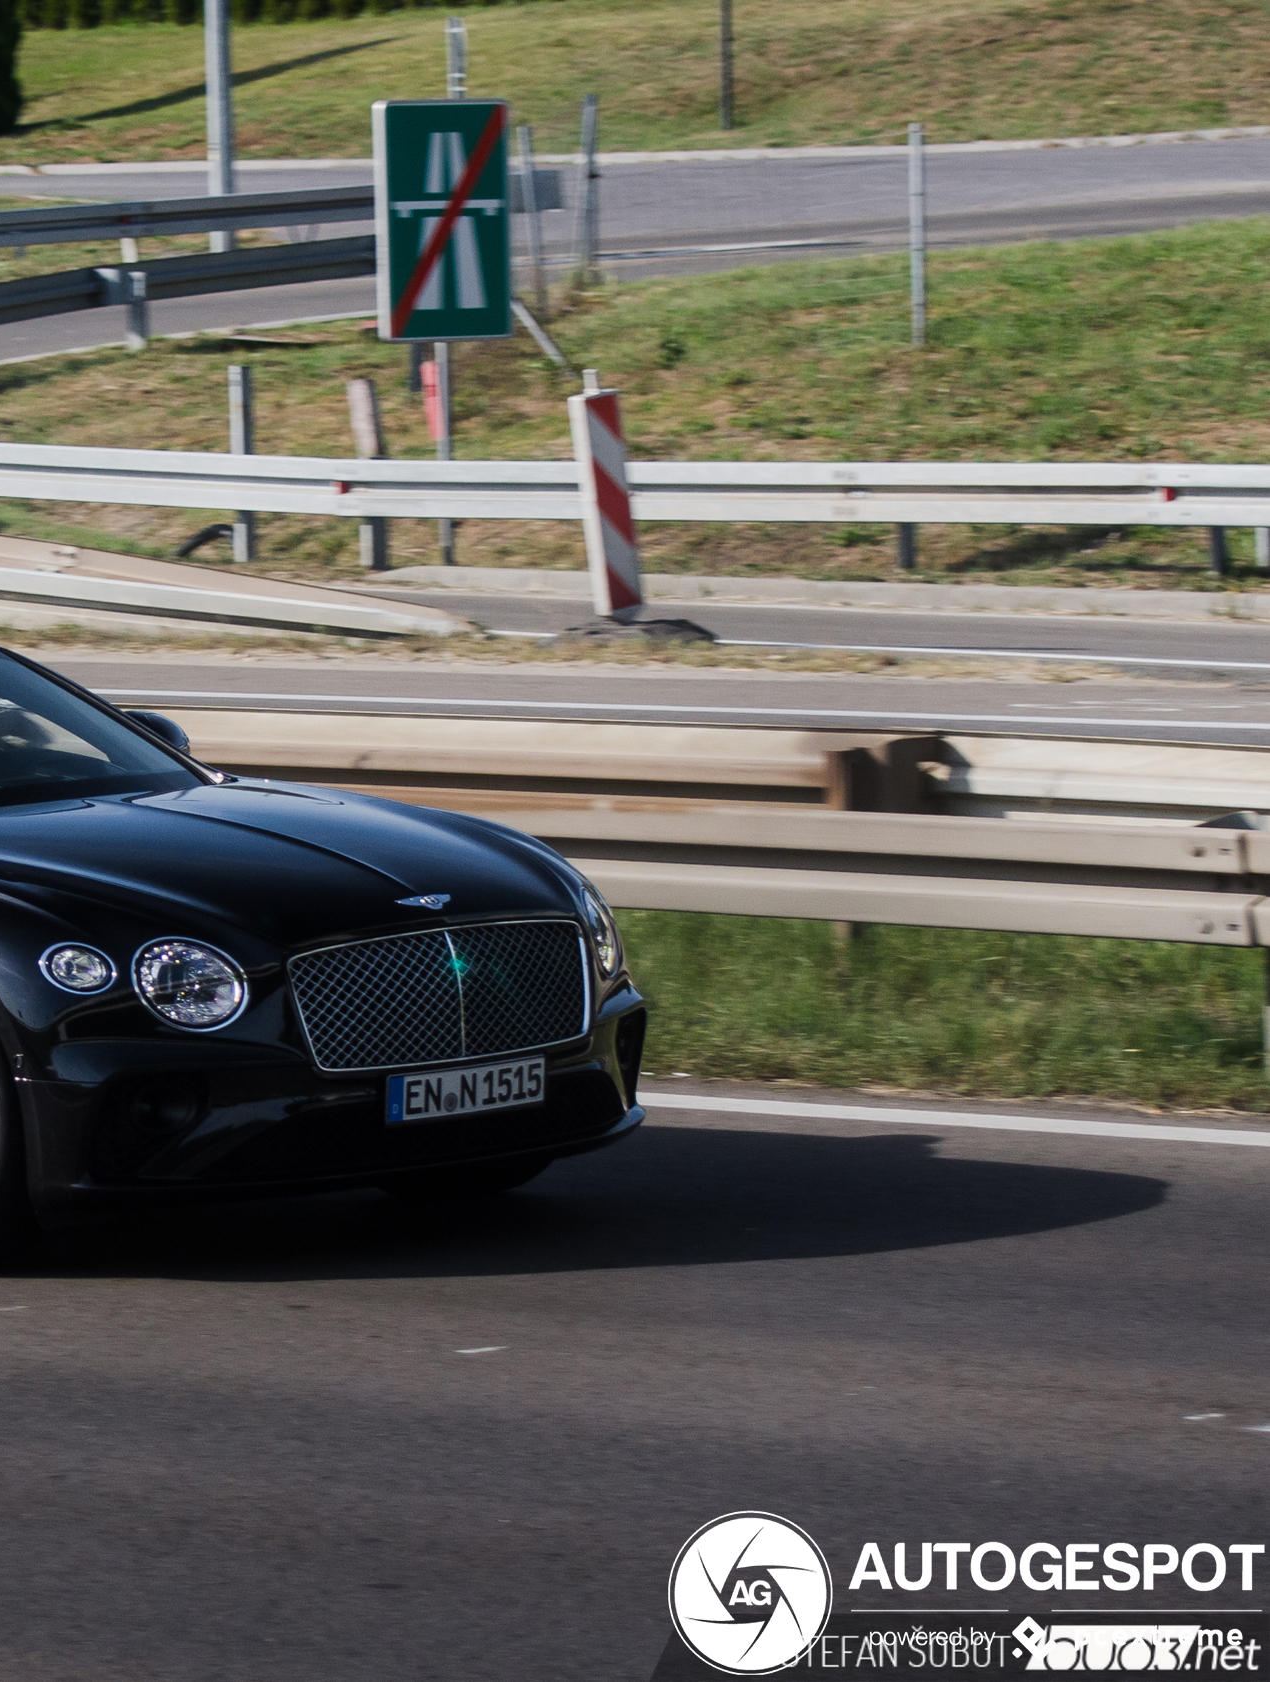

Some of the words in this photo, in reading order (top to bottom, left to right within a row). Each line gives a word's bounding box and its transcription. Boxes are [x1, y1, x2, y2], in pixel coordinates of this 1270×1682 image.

[405, 1077, 442, 1115] EN
[460, 1072, 477, 1108] N
[482, 1062, 541, 1105] 1515
